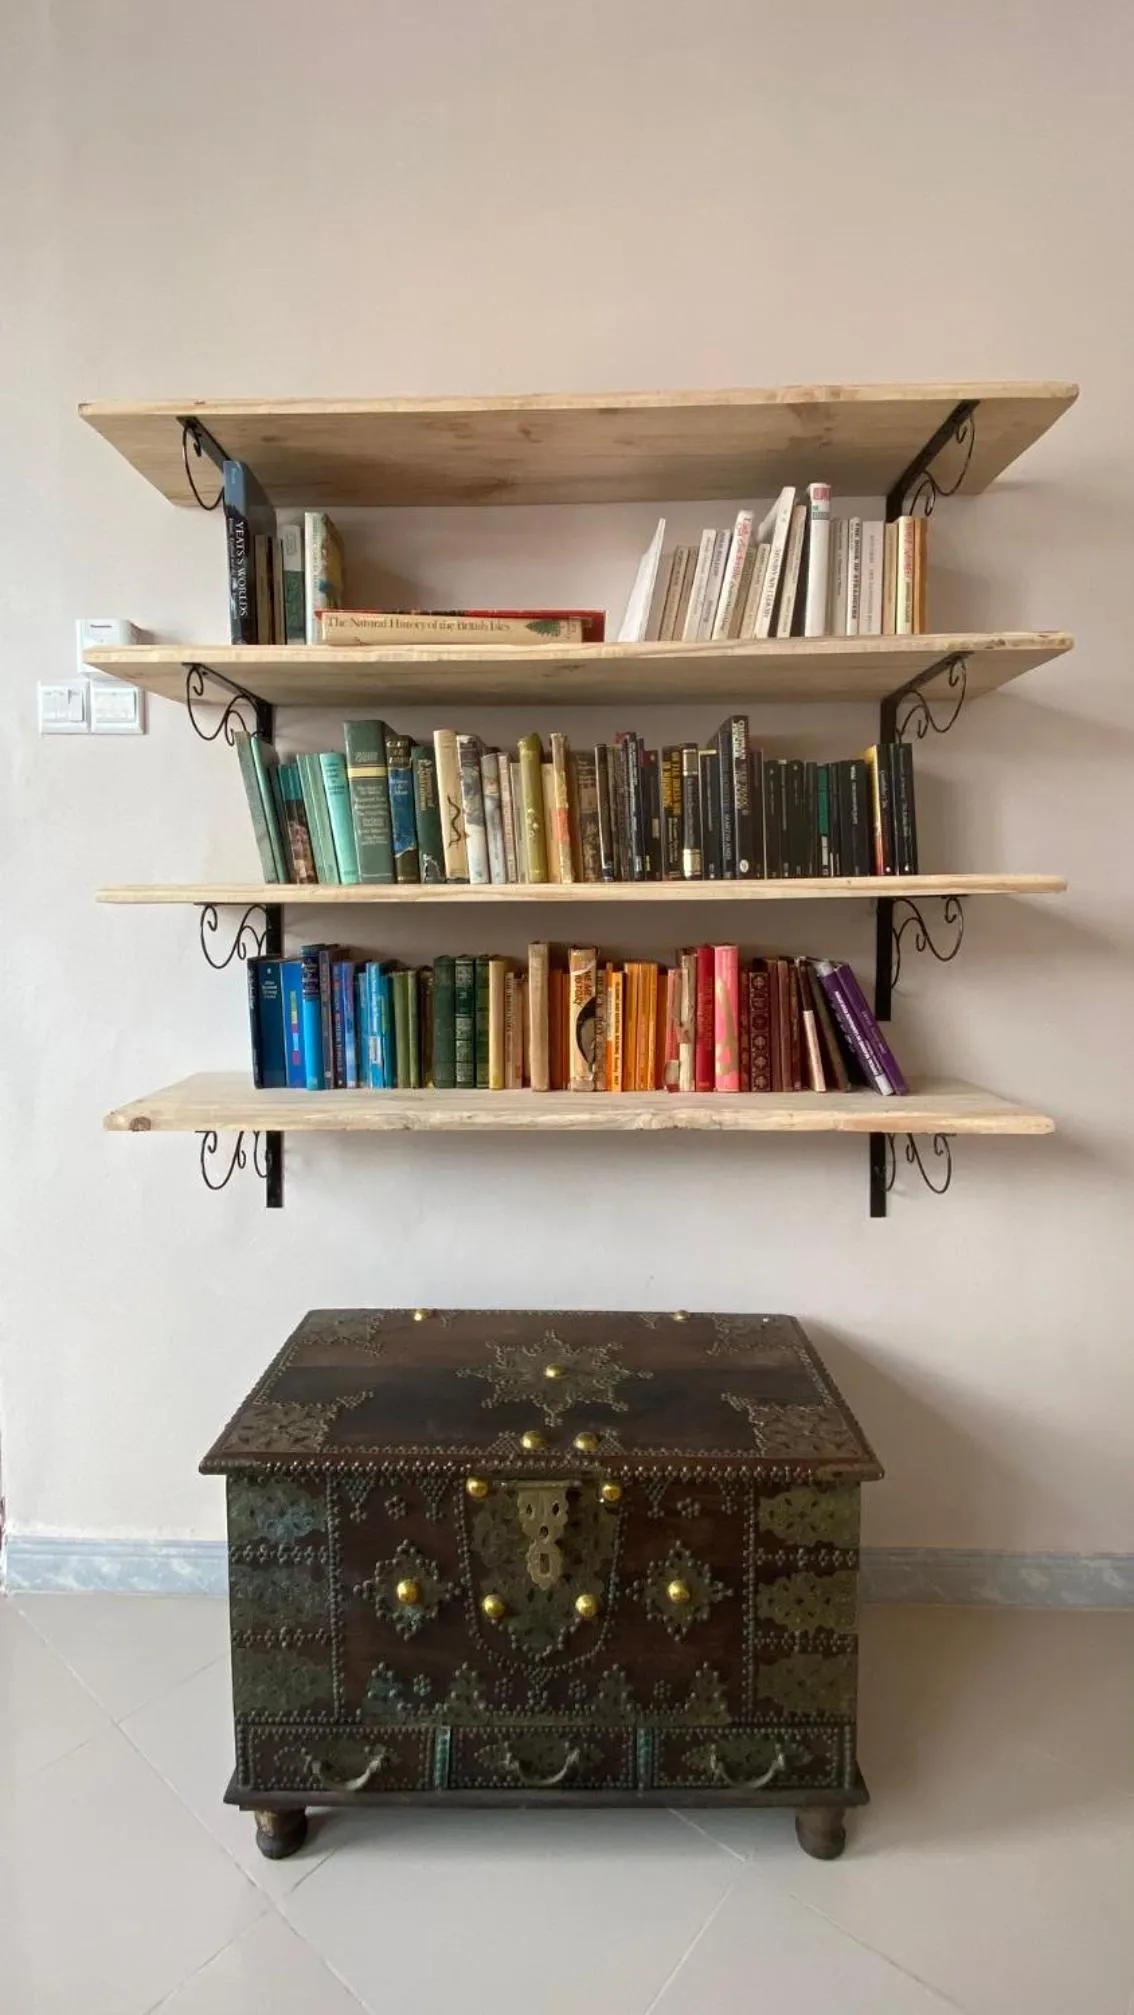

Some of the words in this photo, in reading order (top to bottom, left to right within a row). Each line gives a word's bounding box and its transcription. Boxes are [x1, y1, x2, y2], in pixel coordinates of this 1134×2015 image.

[237, 569, 248, 617] WORLDS
[328, 615, 345, 628] The
[350, 616, 387, 629] Natural
[389, 617, 425, 632] History
